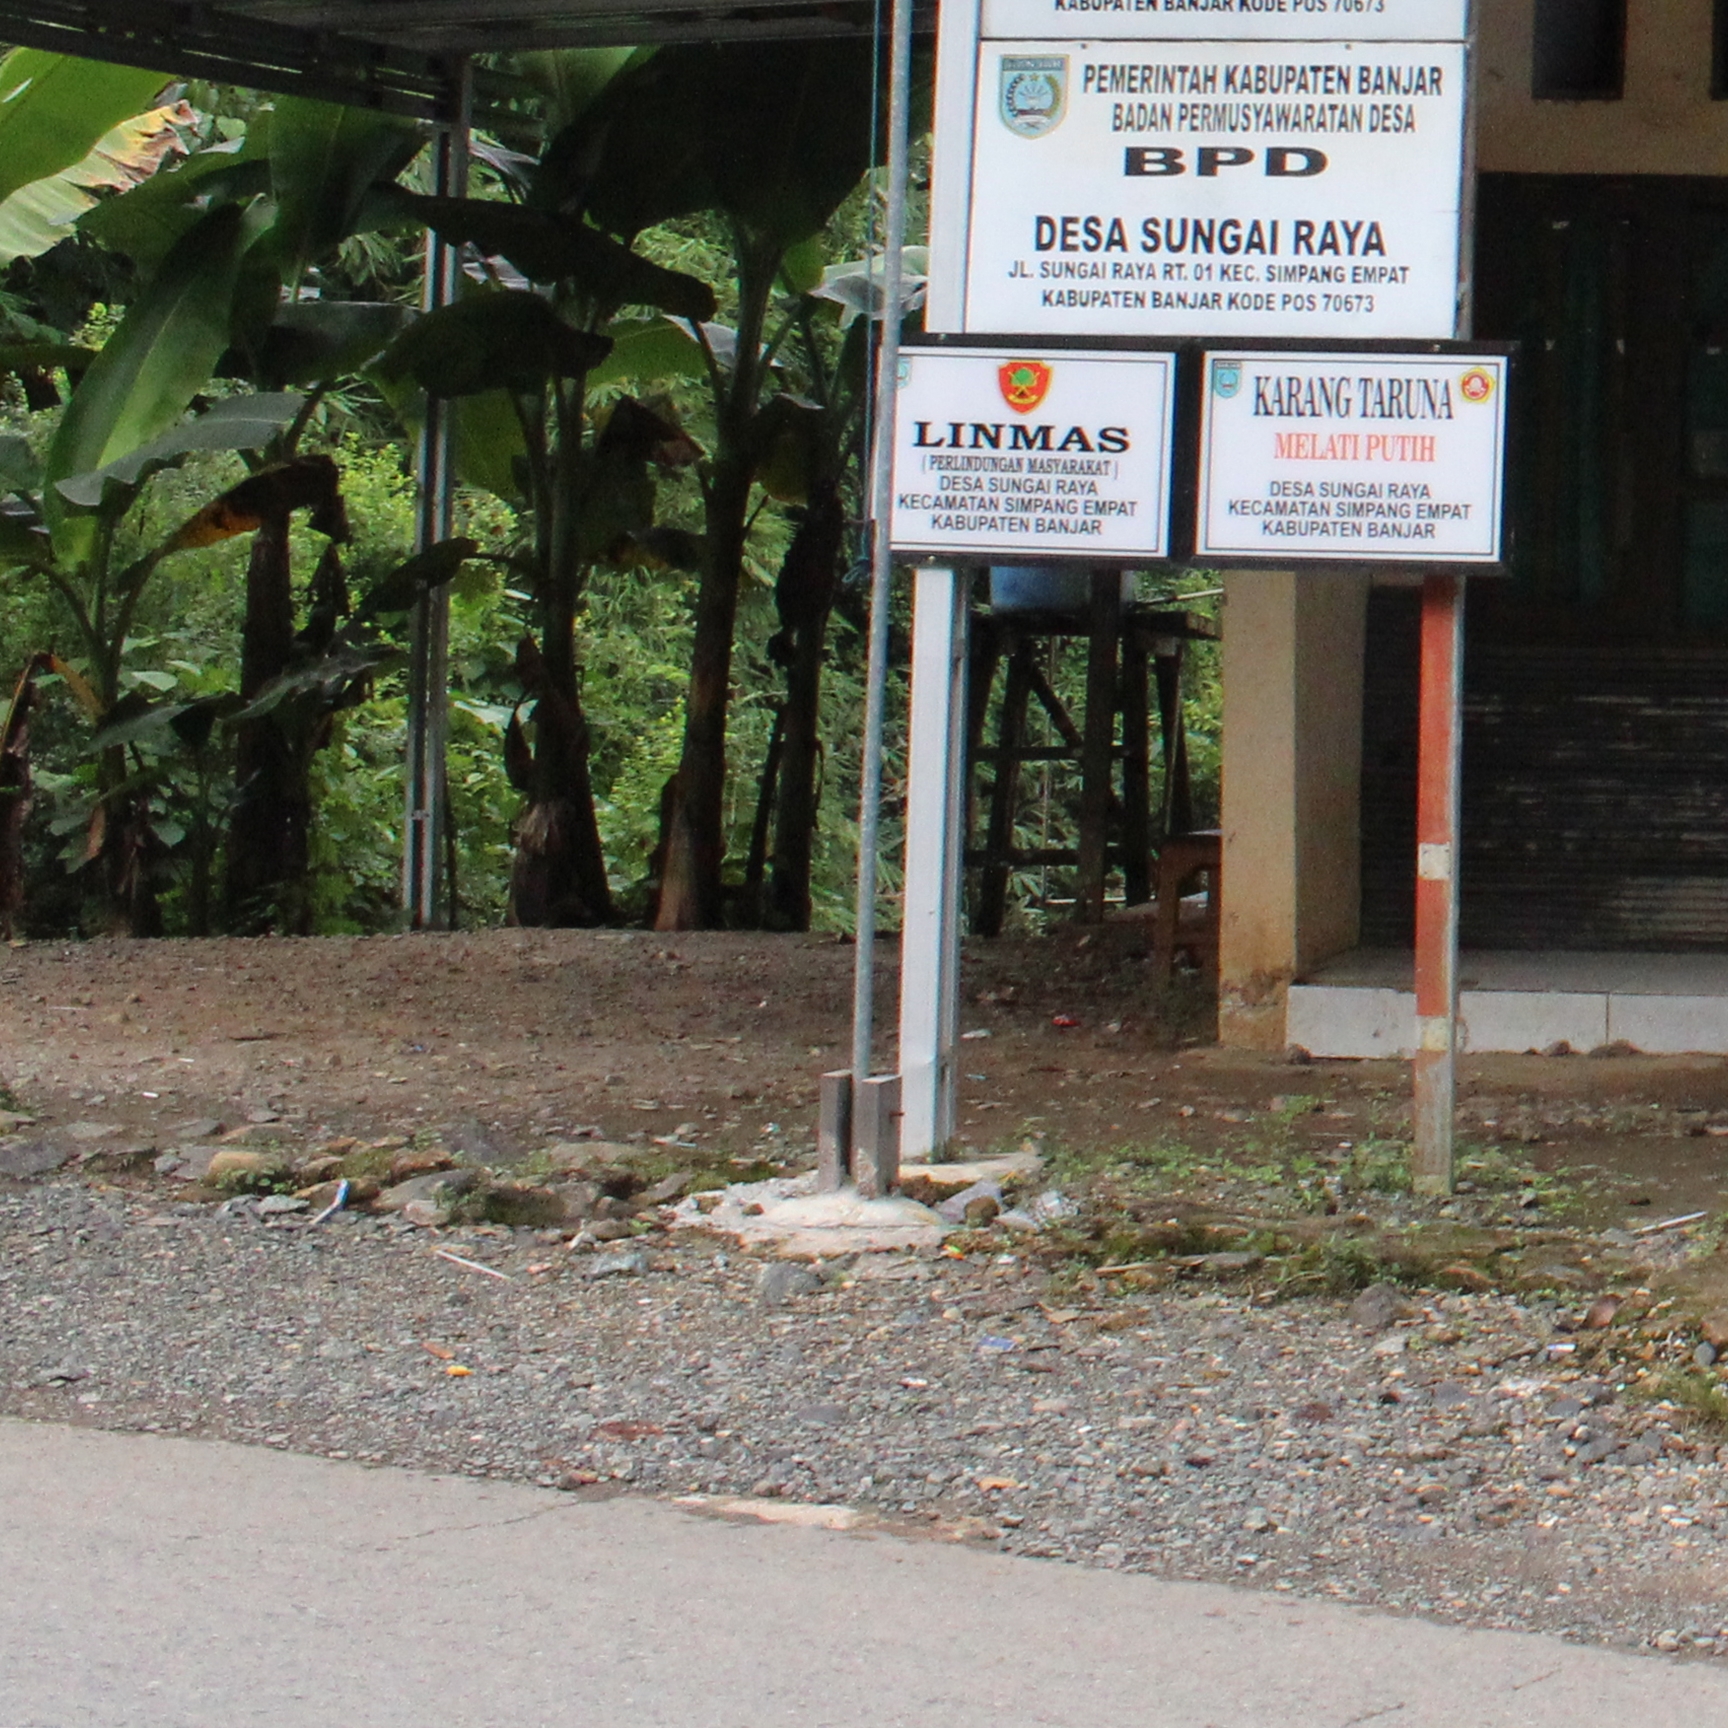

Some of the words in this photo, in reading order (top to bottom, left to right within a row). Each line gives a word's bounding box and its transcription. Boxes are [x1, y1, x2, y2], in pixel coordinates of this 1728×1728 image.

[1083, 64, 1216, 94] PEMERINTAH
[1224, 65, 1350, 95] KABUPATEN
[1358, 66, 1442, 96] BANJAR
[1112, 104, 1172, 133] BADAN
[1178, 104, 1363, 134] PERMUSYAWARATAN
[1369, 105, 1415, 133] DESA
[1124, 147, 1329, 178] BPD
[1035, 215, 1128, 253] DESA
[1140, 218, 1277, 256] SUNGAI
[1293, 220, 1386, 257] RAYA
[1008, 261, 1033, 280] JL.
[1040, 262, 1106, 281] SUNGAI
[1112, 263, 1156, 282] RAYA
[1163, 264, 1188, 282] RT.
[1194, 264, 1213, 282] 01
[1220, 265, 1260, 283] KEC.
[1266, 265, 1345, 284] SIMPANG
[1352, 266, 1409, 284] EMPAT
[1042, 290, 1146, 309] KABUPATEN
[1152, 291, 1222, 310] BANJAR
[1228, 293, 1275, 311] KODE
[1281, 294, 1316, 312] POS
[1323, 294, 1374, 313] 70673
[1253, 375, 1352, 418] KARANG
[1358, 376, 1453, 420] TARUNA
[914, 422, 1130, 453] LINMAS
[1273, 432, 1359, 461] MELATI
[1365, 434, 1435, 462] PUTIH
[930, 455, 1023, 474] PERLINDUNGAN
[1027, 458, 1111, 476] MASYARAKAT
[940, 476, 984, 493] DESA
[988, 478, 1050, 495] SUNGAI
[1056, 479, 1098, 496] RAYA
[1270, 480, 1316, 497] DESA
[1321, 481, 1383, 498] SUNGAI
[1388, 483, 1431, 500] RAYA
[899, 494, 999, 513] KECAMATAN
[1005, 496, 1078, 514] SIMPANG
[1083, 498, 1137, 517] EMPAT
[1229, 500, 1330, 518] KECAMATAN
[1336, 501, 1410, 520] SIMPANG
[1416, 502, 1470, 521] EMPAT
[931, 515, 1030, 533] KABUPATEN
[1035, 518, 1102, 535] BANJAR
[1262, 520, 1363, 538] KABUPATEN
[1368, 522, 1435, 539] BANJAR
